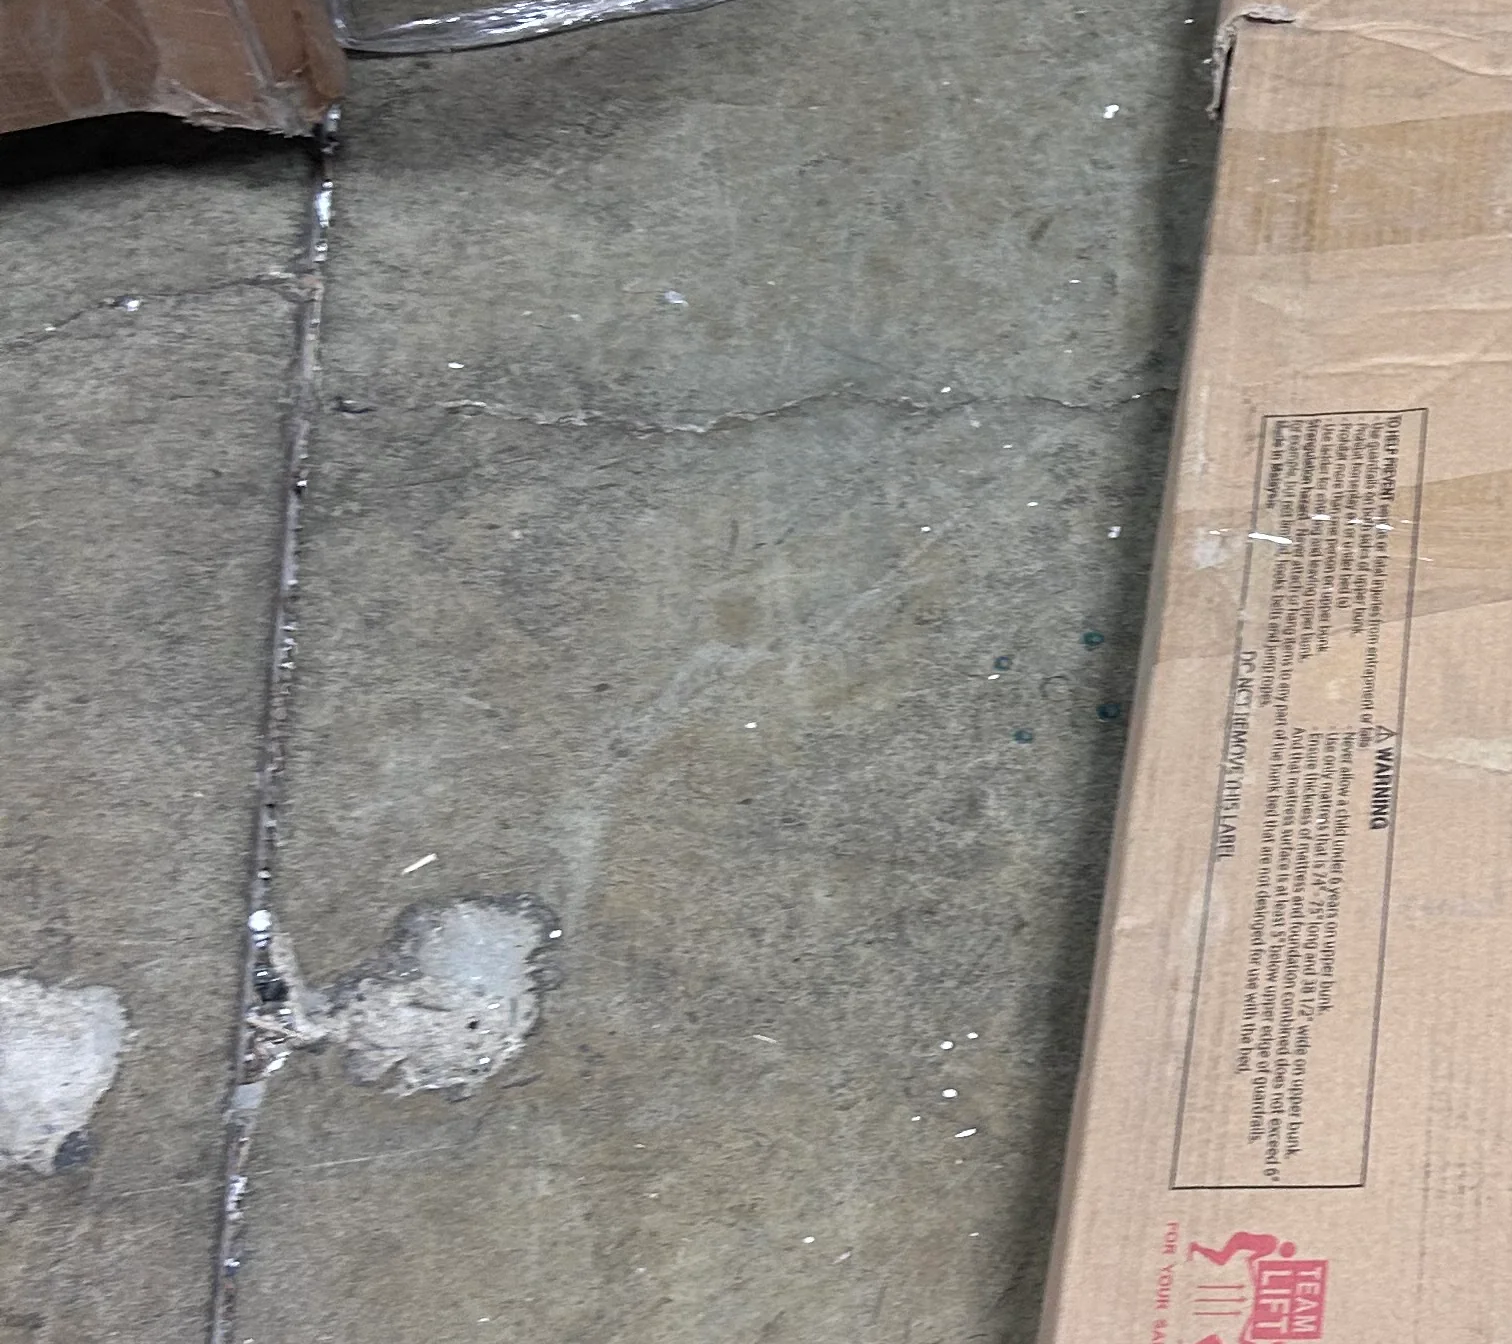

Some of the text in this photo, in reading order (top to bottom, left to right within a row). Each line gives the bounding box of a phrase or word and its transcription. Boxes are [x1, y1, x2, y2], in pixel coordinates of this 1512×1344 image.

[1385, 429, 1401, 454] HELP
[1369, 747, 1395, 830] WARNING
[1334, 809, 1351, 836] child
[1324, 922, 1338, 937] on
[1317, 941, 1336, 977] upper
[1295, 1024, 1312, 1055] wide
[1293, 1059, 1306, 1075] on
[1285, 1079, 1304, 1117] upper
[1162, 1222, 1179, 1255] FOR
[1155, 1264, 1173, 1310] YOUR
[1255, 1270, 1292, 1334] LIFT
[1292, 1267, 1322, 1334] TEAM
